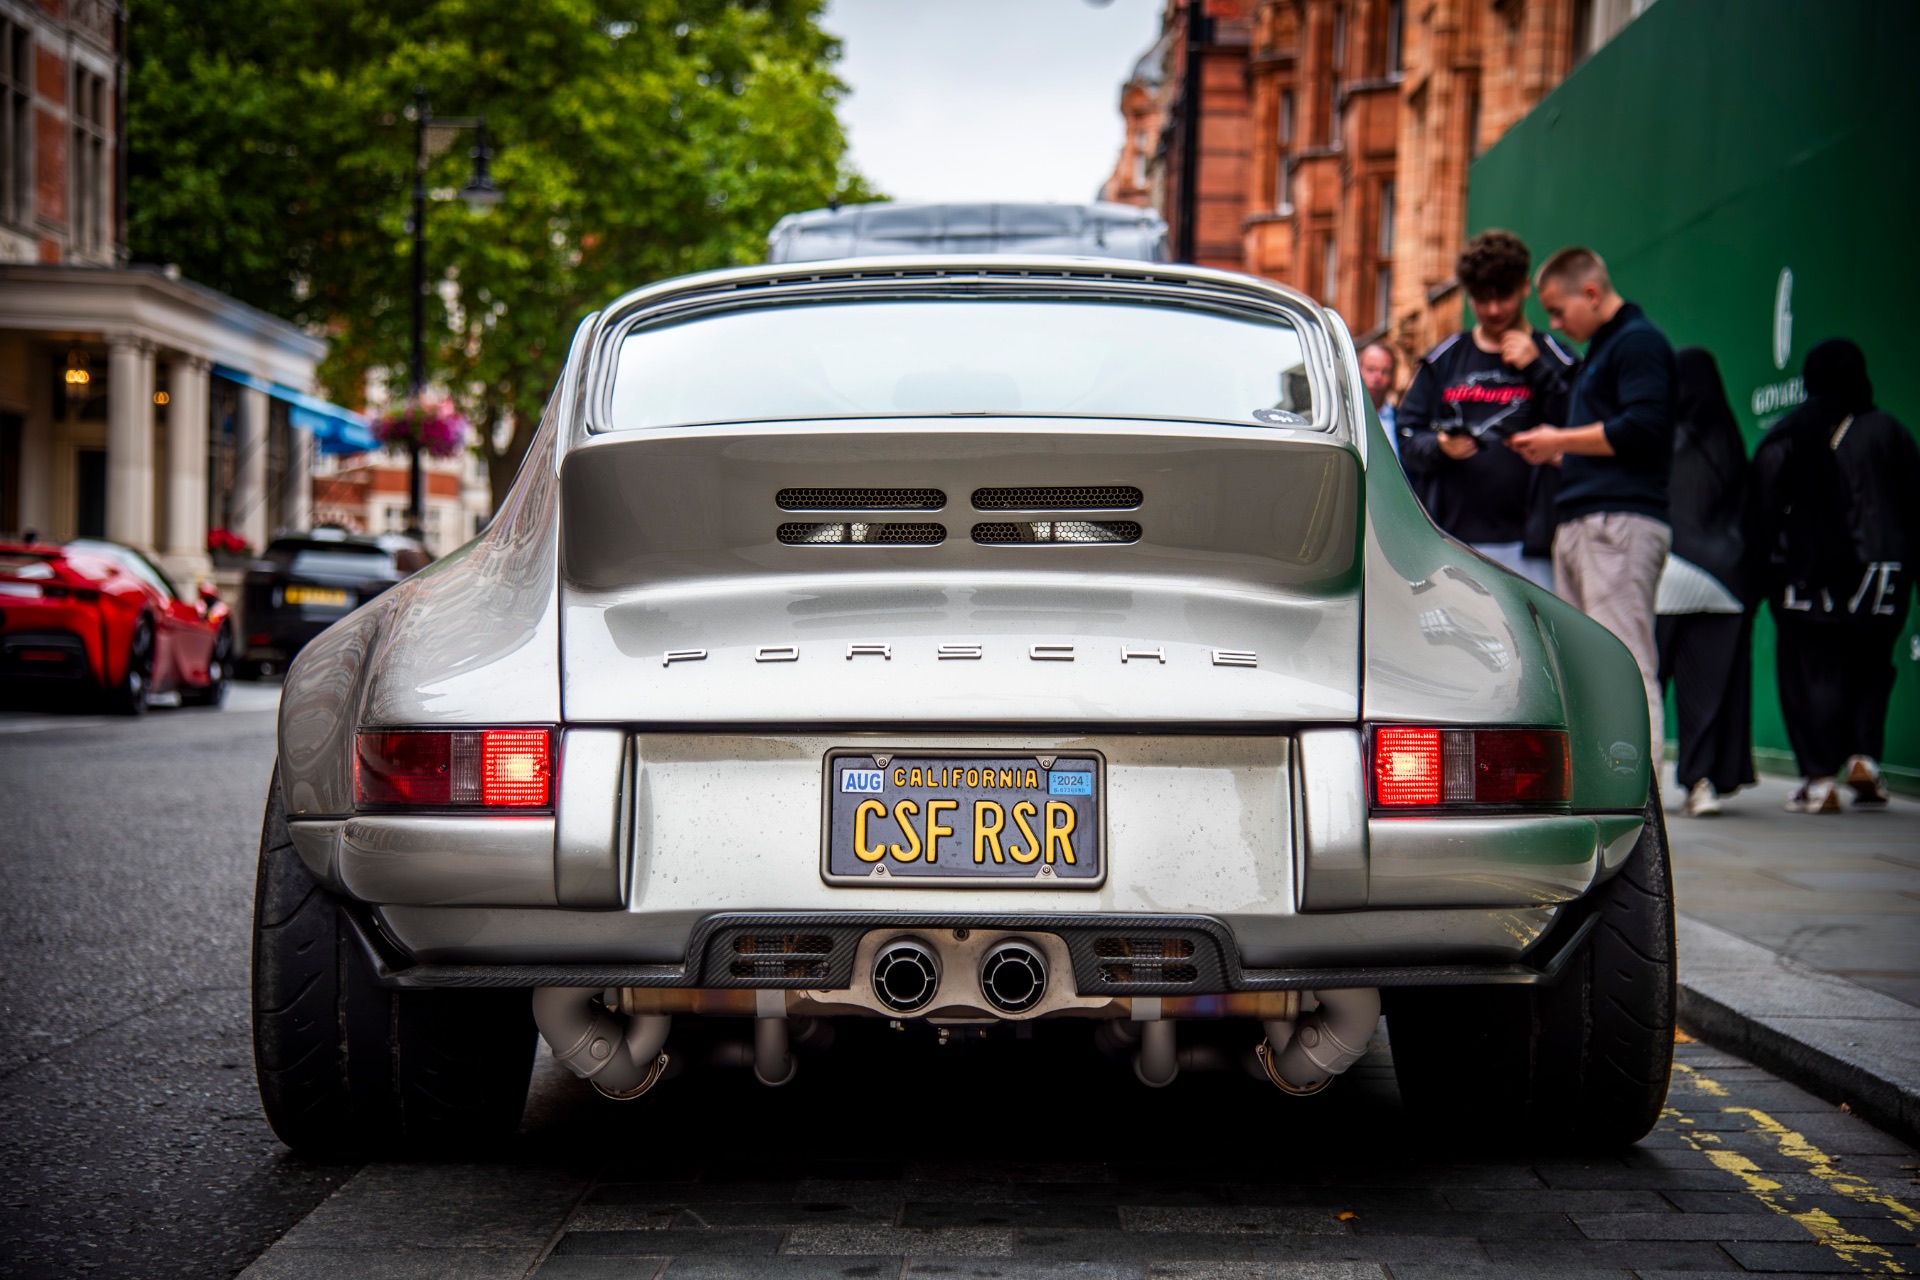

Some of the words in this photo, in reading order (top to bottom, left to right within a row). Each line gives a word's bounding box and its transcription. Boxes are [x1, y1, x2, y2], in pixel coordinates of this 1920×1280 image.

[663, 642, 1257, 668] PORSCHE
[845, 773, 881, 790] AUG
[893, 768, 1039, 788] CALIFORNIA
[1057, 775, 1084, 786] 2024
[854, 799, 958, 863] CSF
[973, 799, 1078, 864] RSR
